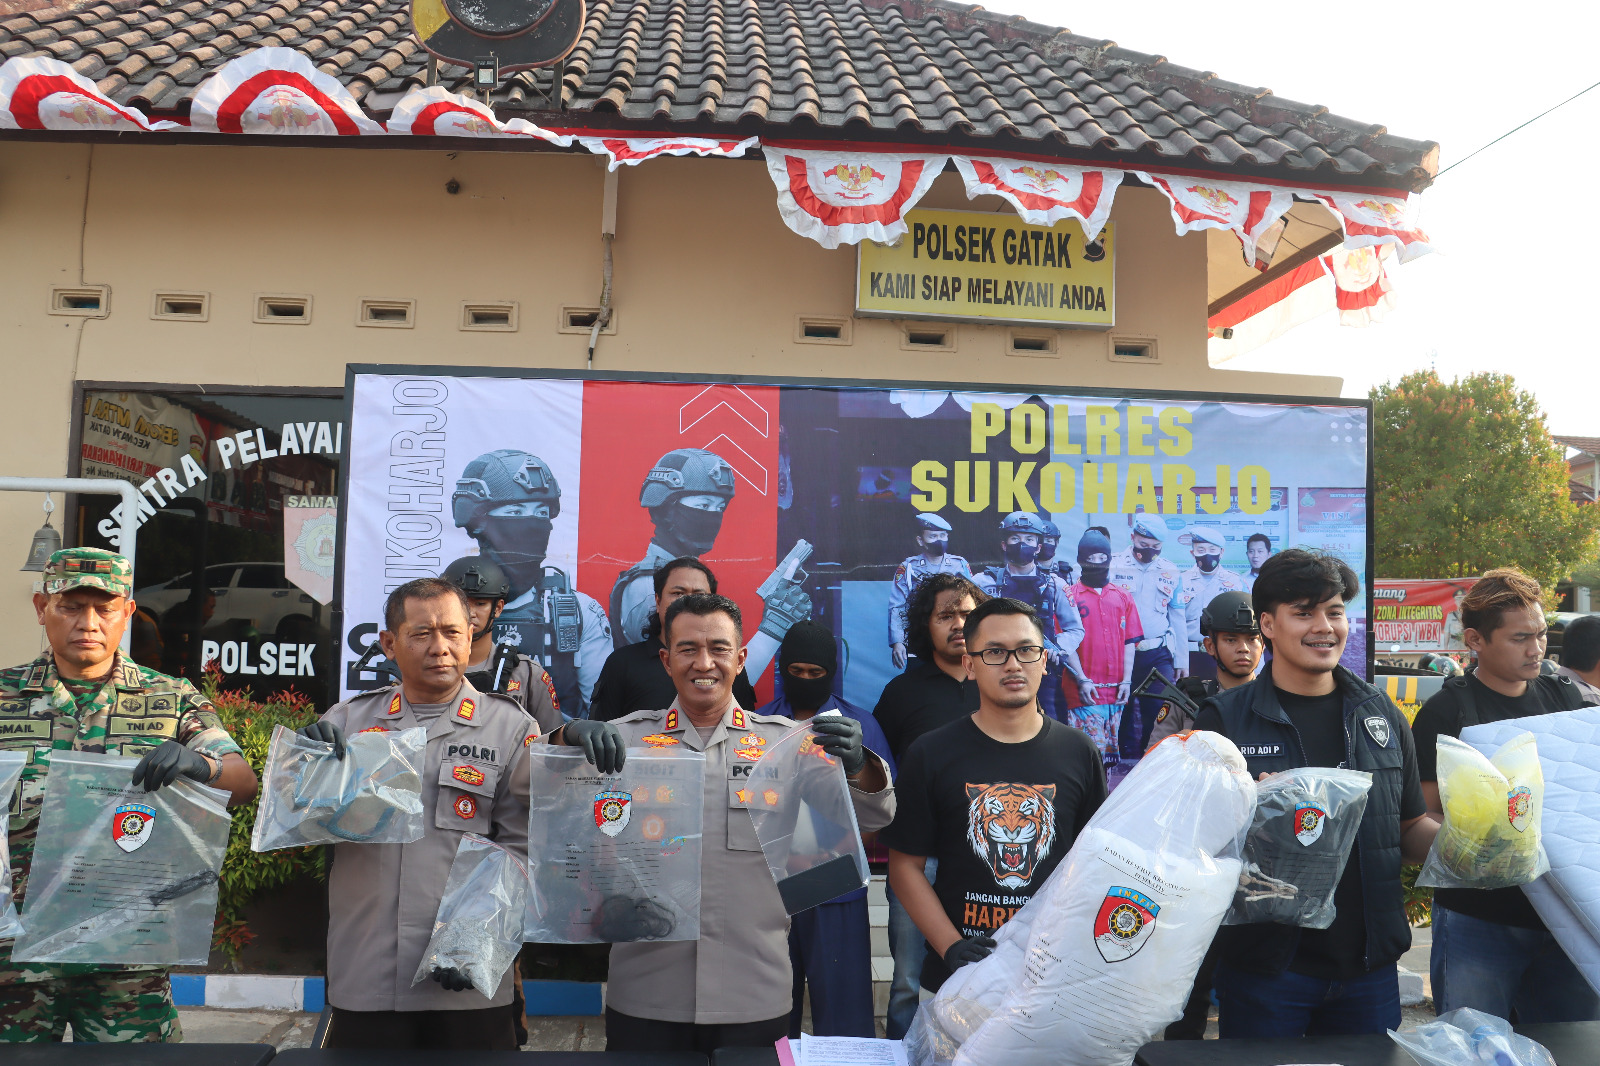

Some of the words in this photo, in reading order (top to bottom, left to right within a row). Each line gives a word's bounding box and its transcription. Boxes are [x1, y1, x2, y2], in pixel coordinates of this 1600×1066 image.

[913, 222, 996, 263] POLSEK
[1003, 228, 1071, 269] GATAK
[870, 271, 915, 299] KAMI
[922, 275, 962, 302] SIAP
[967, 277, 1054, 308] MELAYANI
[1059, 284, 1107, 312] ANDA
[970, 402, 1193, 457] POLRES
[384, 379, 449, 595] UKOHARJO
[910, 460, 1270, 515] SUKOHARJO
[288, 495, 338, 508] SAMA
[1374, 589, 1407, 602] atang
[1376, 605, 1397, 620] ZONA
[1398, 605, 1443, 620] INTEGRITAS
[497, 624, 518, 632] TIM
[201, 640, 317, 677] POLSEK
[126, 722, 147, 731] TNI
[149, 721, 164, 731] AD
[448, 744, 496, 762] POLRI
[1258, 746, 1271, 754] ADI
[1273, 745, 1280, 754] P
[964, 891, 1001, 906] JANGAN
[1002, 895, 1031, 905] BANG
[1118, 888, 1156, 910] INAFIS
[963, 903, 1021, 929] HARI
